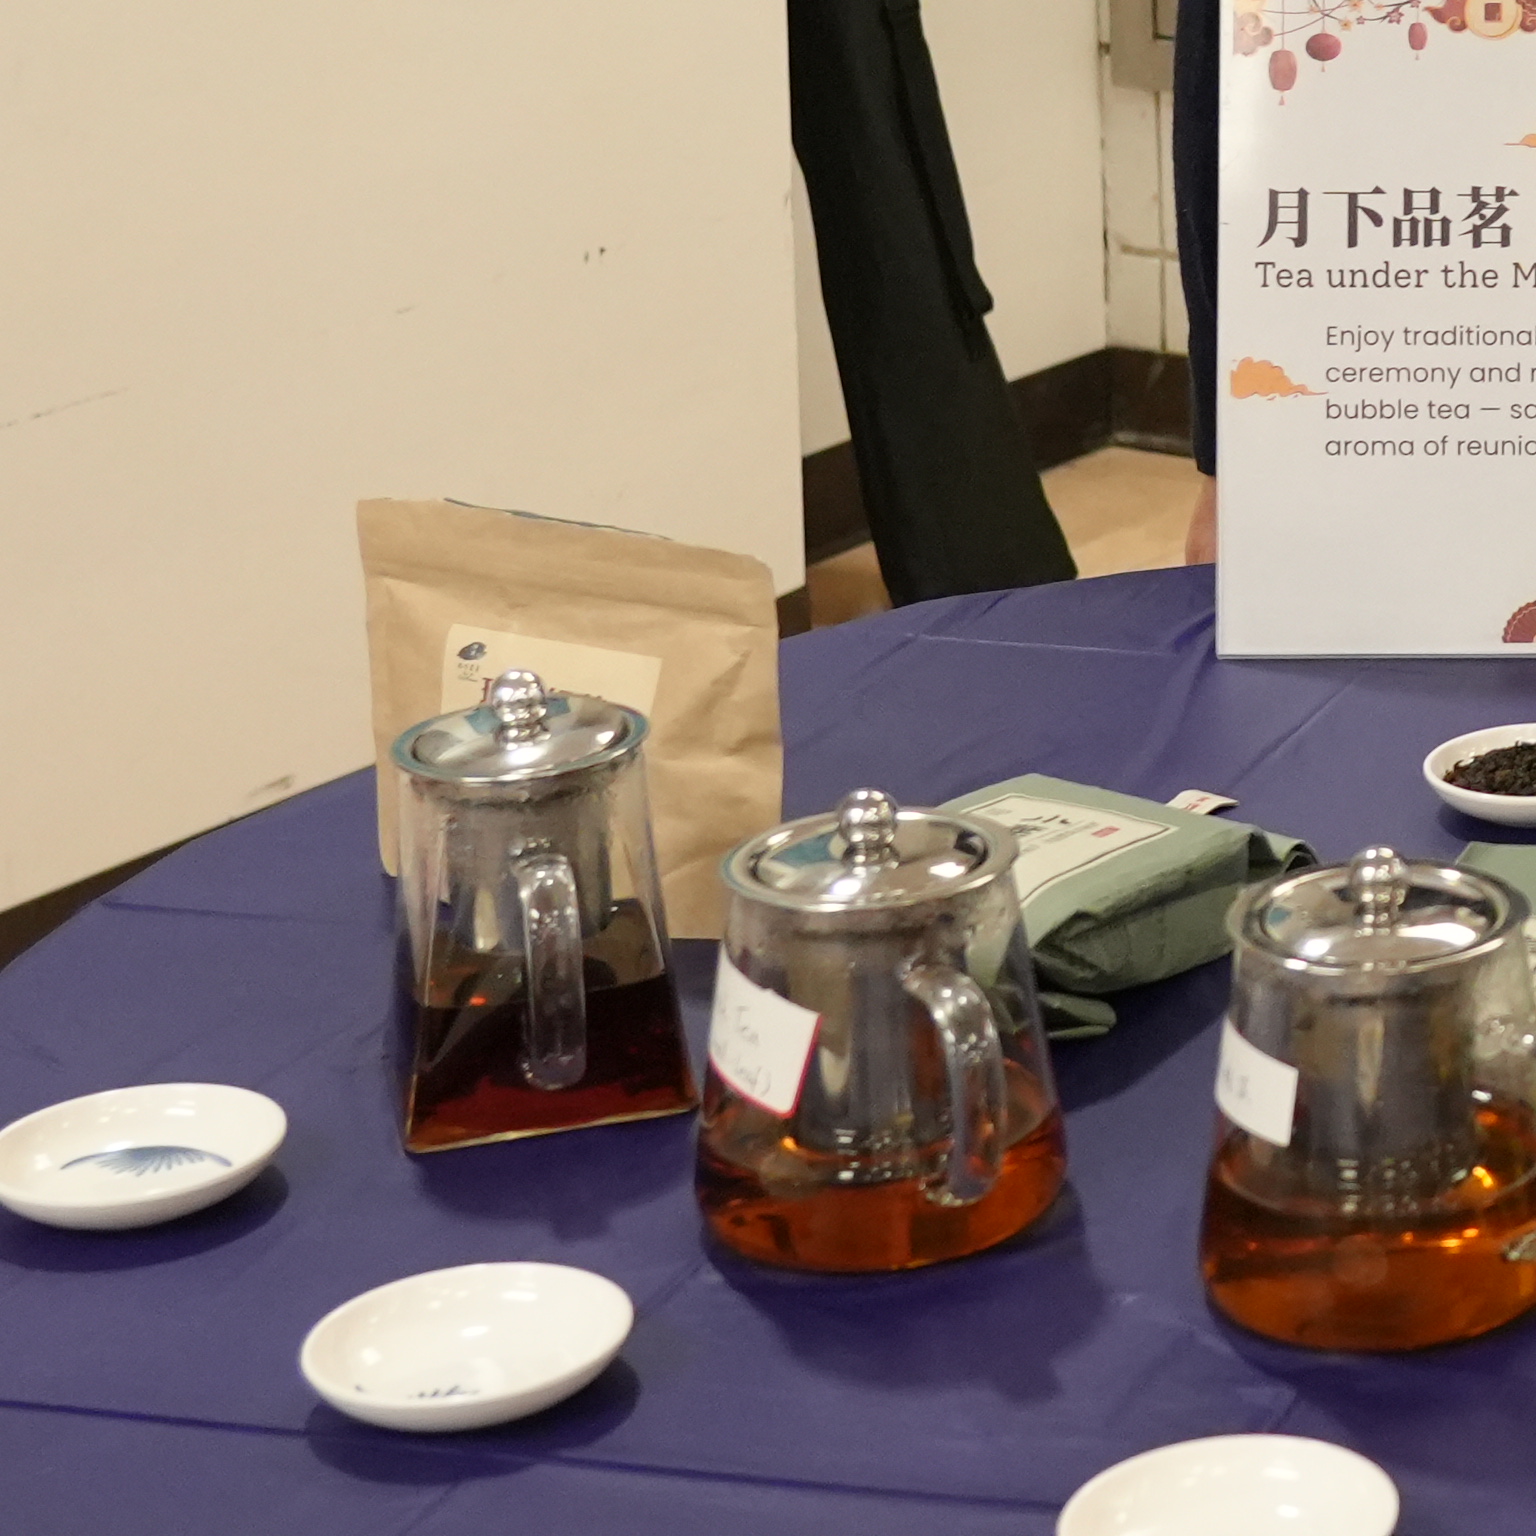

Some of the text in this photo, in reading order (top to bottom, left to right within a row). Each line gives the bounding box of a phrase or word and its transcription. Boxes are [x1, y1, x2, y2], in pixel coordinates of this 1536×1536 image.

[1256, 185, 1520, 249] 月下品茗
[1254, 261, 1315, 289] Tea
[1326, 260, 1430, 289] under
[1440, 260, 1500, 289] the
[1326, 324, 1395, 353] Enjoy
[1325, 364, 1462, 390] ceremony
[1469, 362, 1521, 383] and
[1325, 398, 1419, 420] bubble
[1427, 400, 1470, 420] tea
[1324, 438, 1415, 457] aroma
[1423, 434, 1449, 456] of
